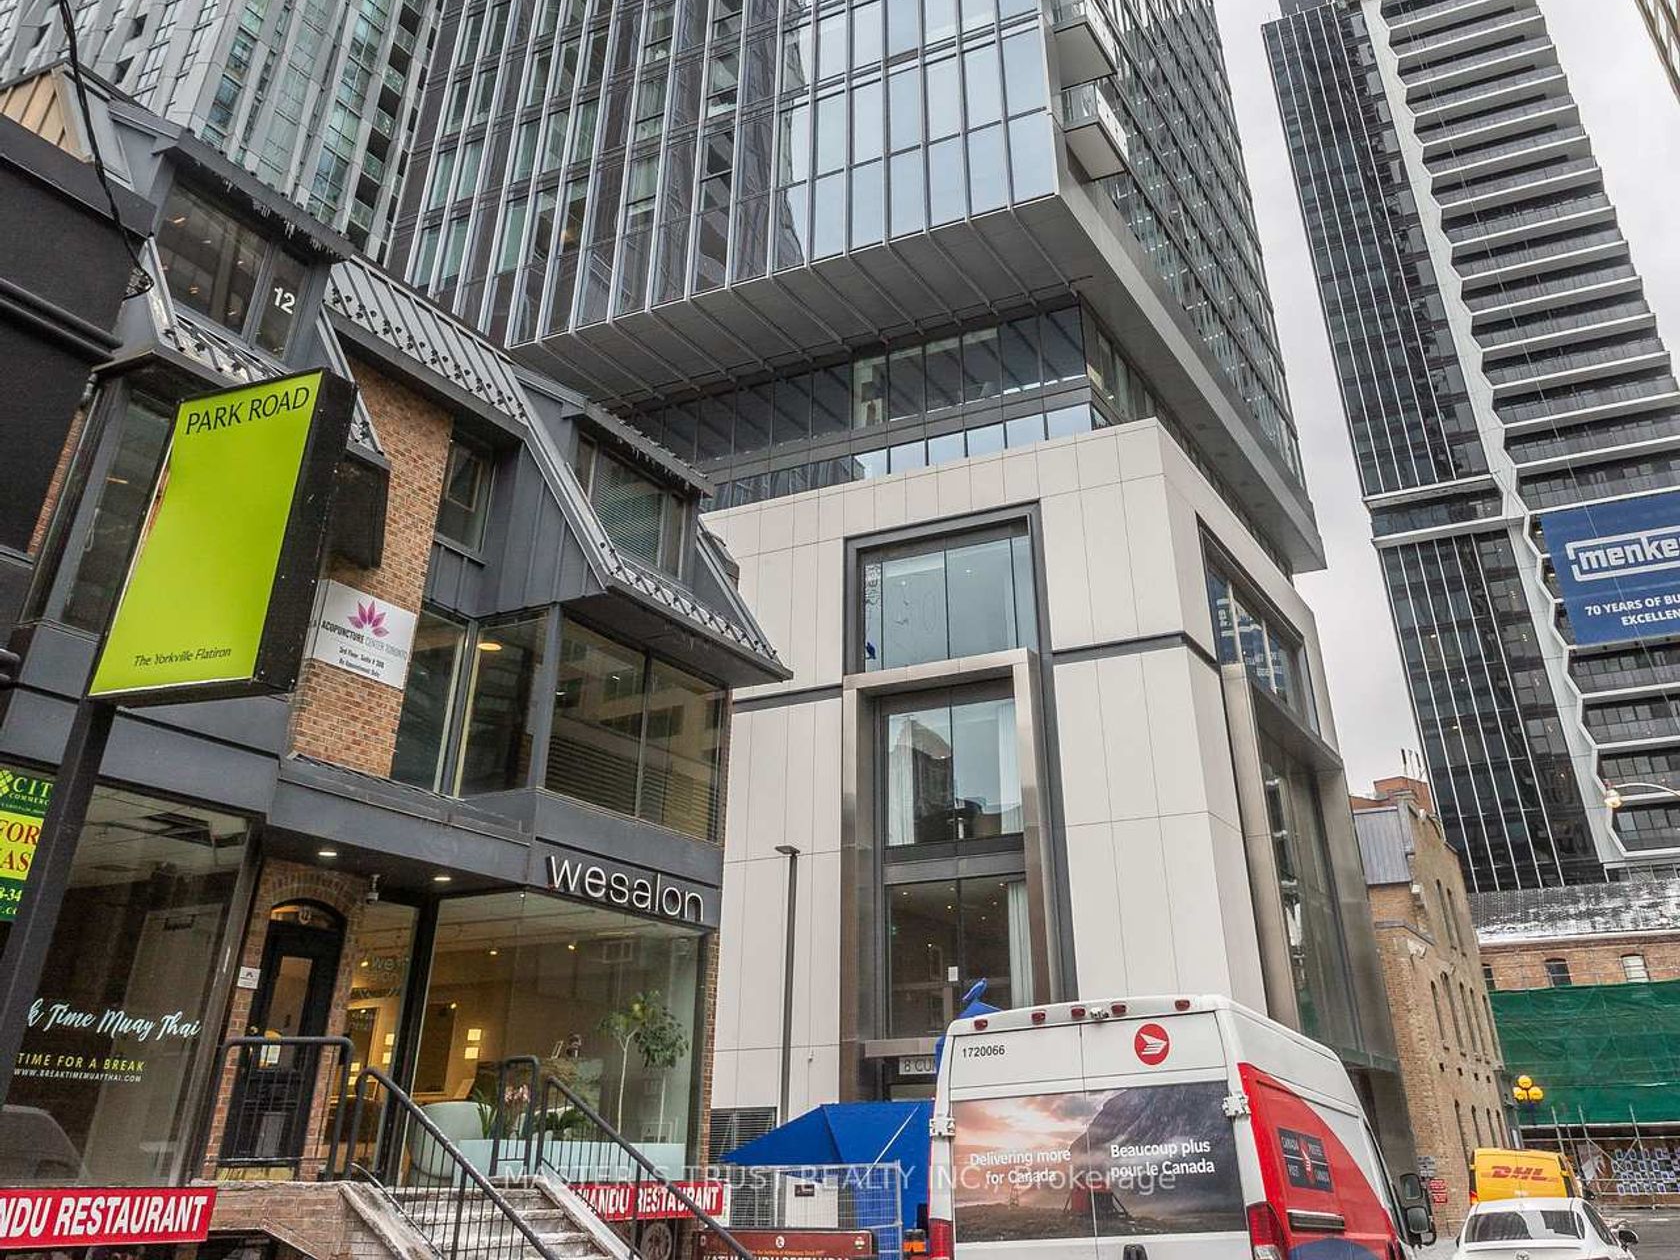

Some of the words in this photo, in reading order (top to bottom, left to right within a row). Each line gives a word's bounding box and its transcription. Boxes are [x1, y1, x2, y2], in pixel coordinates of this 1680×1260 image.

[274, 287, 295, 314] 12
[186, 402, 243, 435] PARK
[248, 387, 310, 421] ROAD
[1578, 537, 1680, 570] menke
[1585, 604, 1601, 616] 70
[1602, 599, 1643, 613] YEARS
[1644, 596, 1661, 607] OF
[134, 655, 151, 666] The
[154, 651, 194, 665] Yorkville
[195, 647, 231, 660] Flatiron
[13, 777, 54, 798] CIT
[0, 848, 31, 873] AS
[551, 856, 704, 923] wesalon
[43, 1004, 96, 1032] Time
[96, 1009, 156, 1042] Muay
[157, 1011, 201, 1040] Thai
[963, 1044, 1006, 1058] 1720066
[18, 1053, 52, 1067] TIME
[57, 1055, 83, 1068] FOR
[88, 1058, 98, 1069] A
[103, 1058, 145, 1072] BREAK
[970, 1150, 1034, 1167] Delivering
[1037, 1149, 1071, 1162] more
[1110, 1143, 1178, 1159] Beaucoup
[1182, 1138, 1211, 1156] plus
[986, 1170, 1005, 1185] for
[1008, 1168, 1057, 1184] Canada
[1110, 1165, 1144, 1180] pour
[1146, 1161, 1159, 1176] le
[1161, 1157, 1216, 1175] Canada
[1491, 1165, 1547, 1182] DHL
[53, 1195, 208, 1237] RESTAURANT
